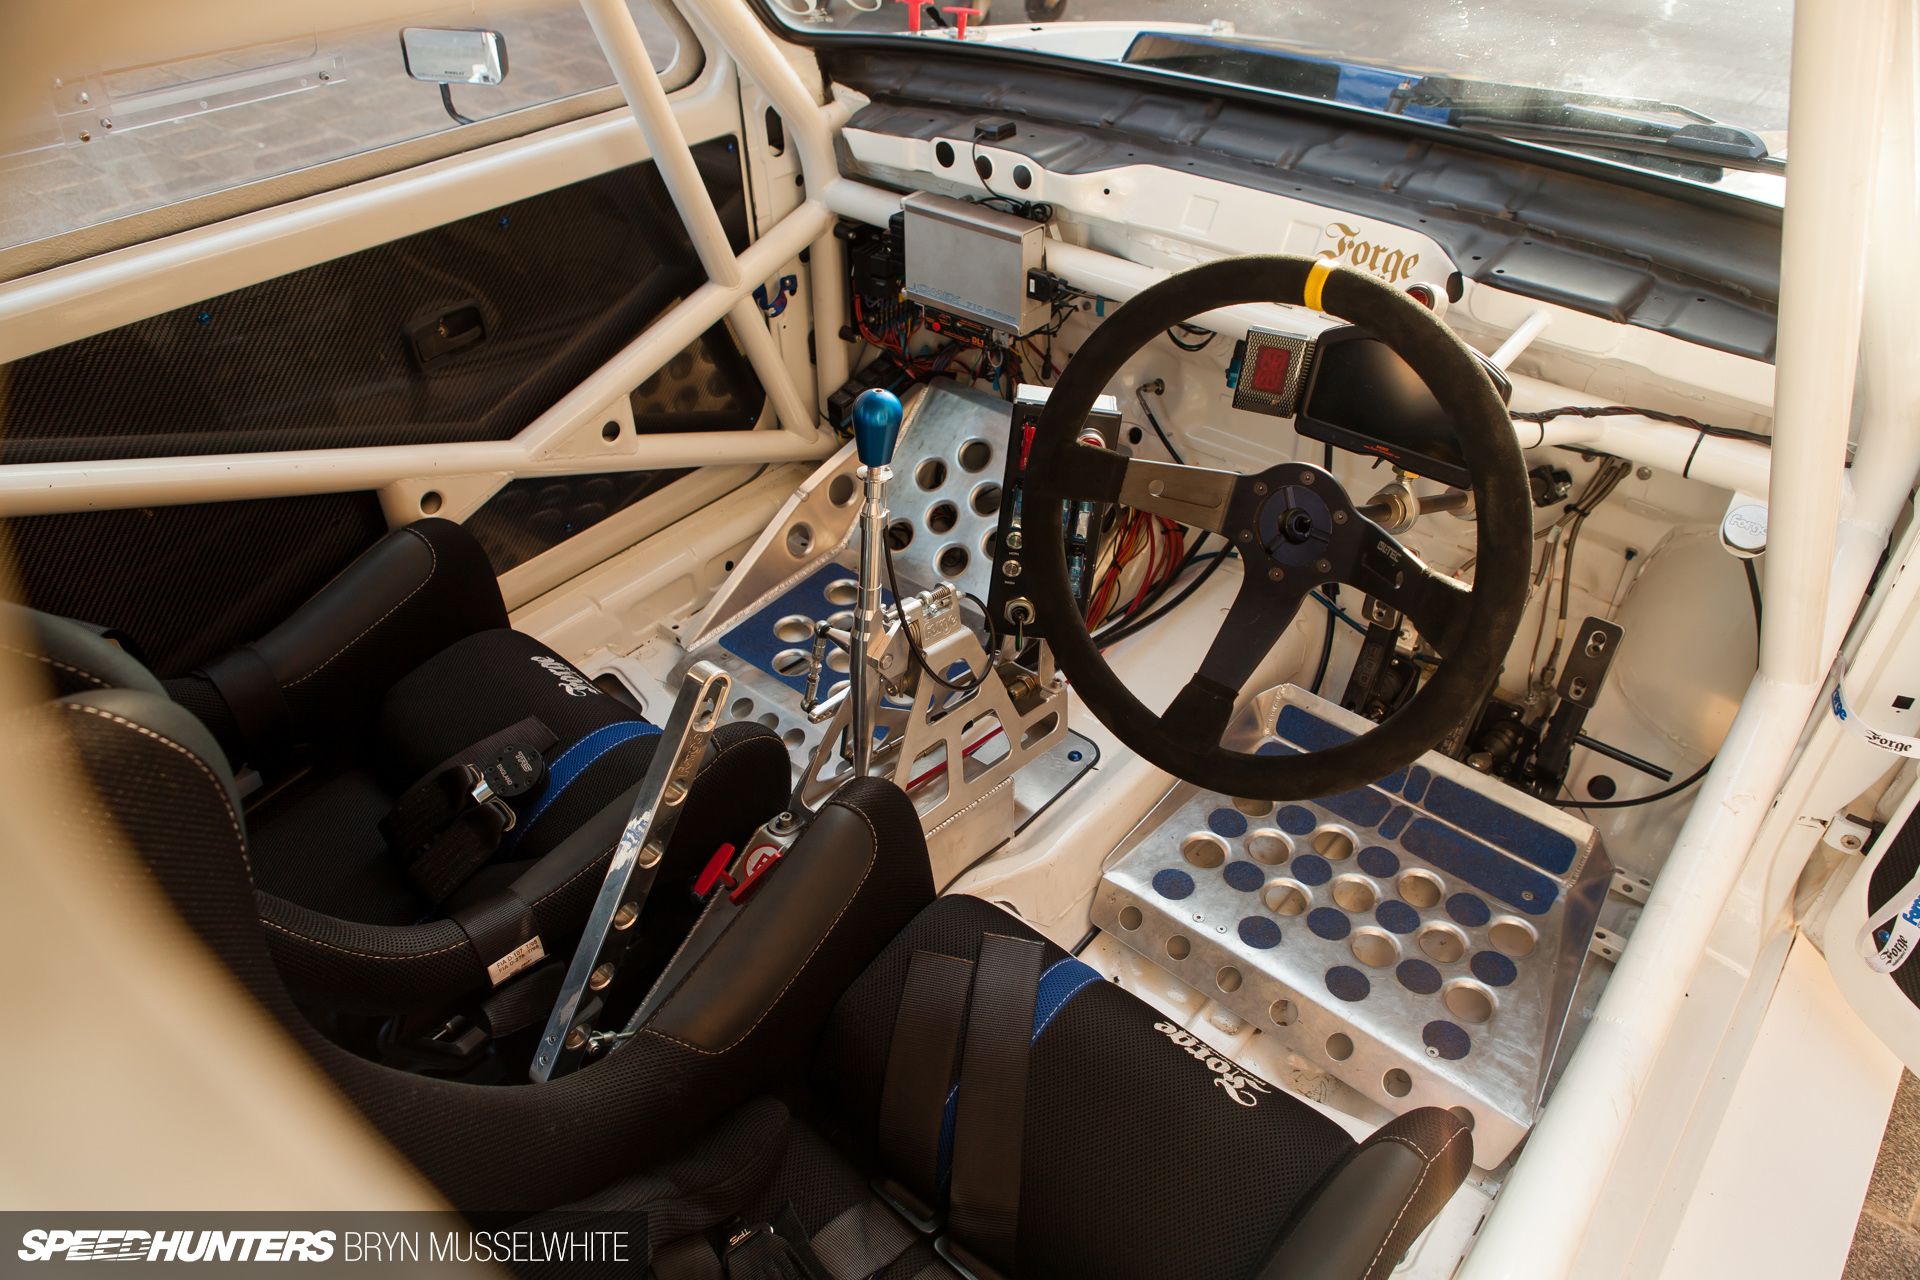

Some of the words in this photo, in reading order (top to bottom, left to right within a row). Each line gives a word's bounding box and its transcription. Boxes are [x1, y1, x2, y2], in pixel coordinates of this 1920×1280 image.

[1316, 222, 1420, 283] Forge
[966, 301, 984, 313] 710
[971, 335, 985, 348] DL1
[1864, 728, 1913, 753] Forge
[515, 750, 533, 772] TRS
[496, 763, 513, 786] ENGLAND
[1902, 893, 1920, 927] forg
[1879, 934, 1909, 966] Forge
[496, 959, 507, 969] FIA
[1154, 1021, 1272, 1107] Forge
